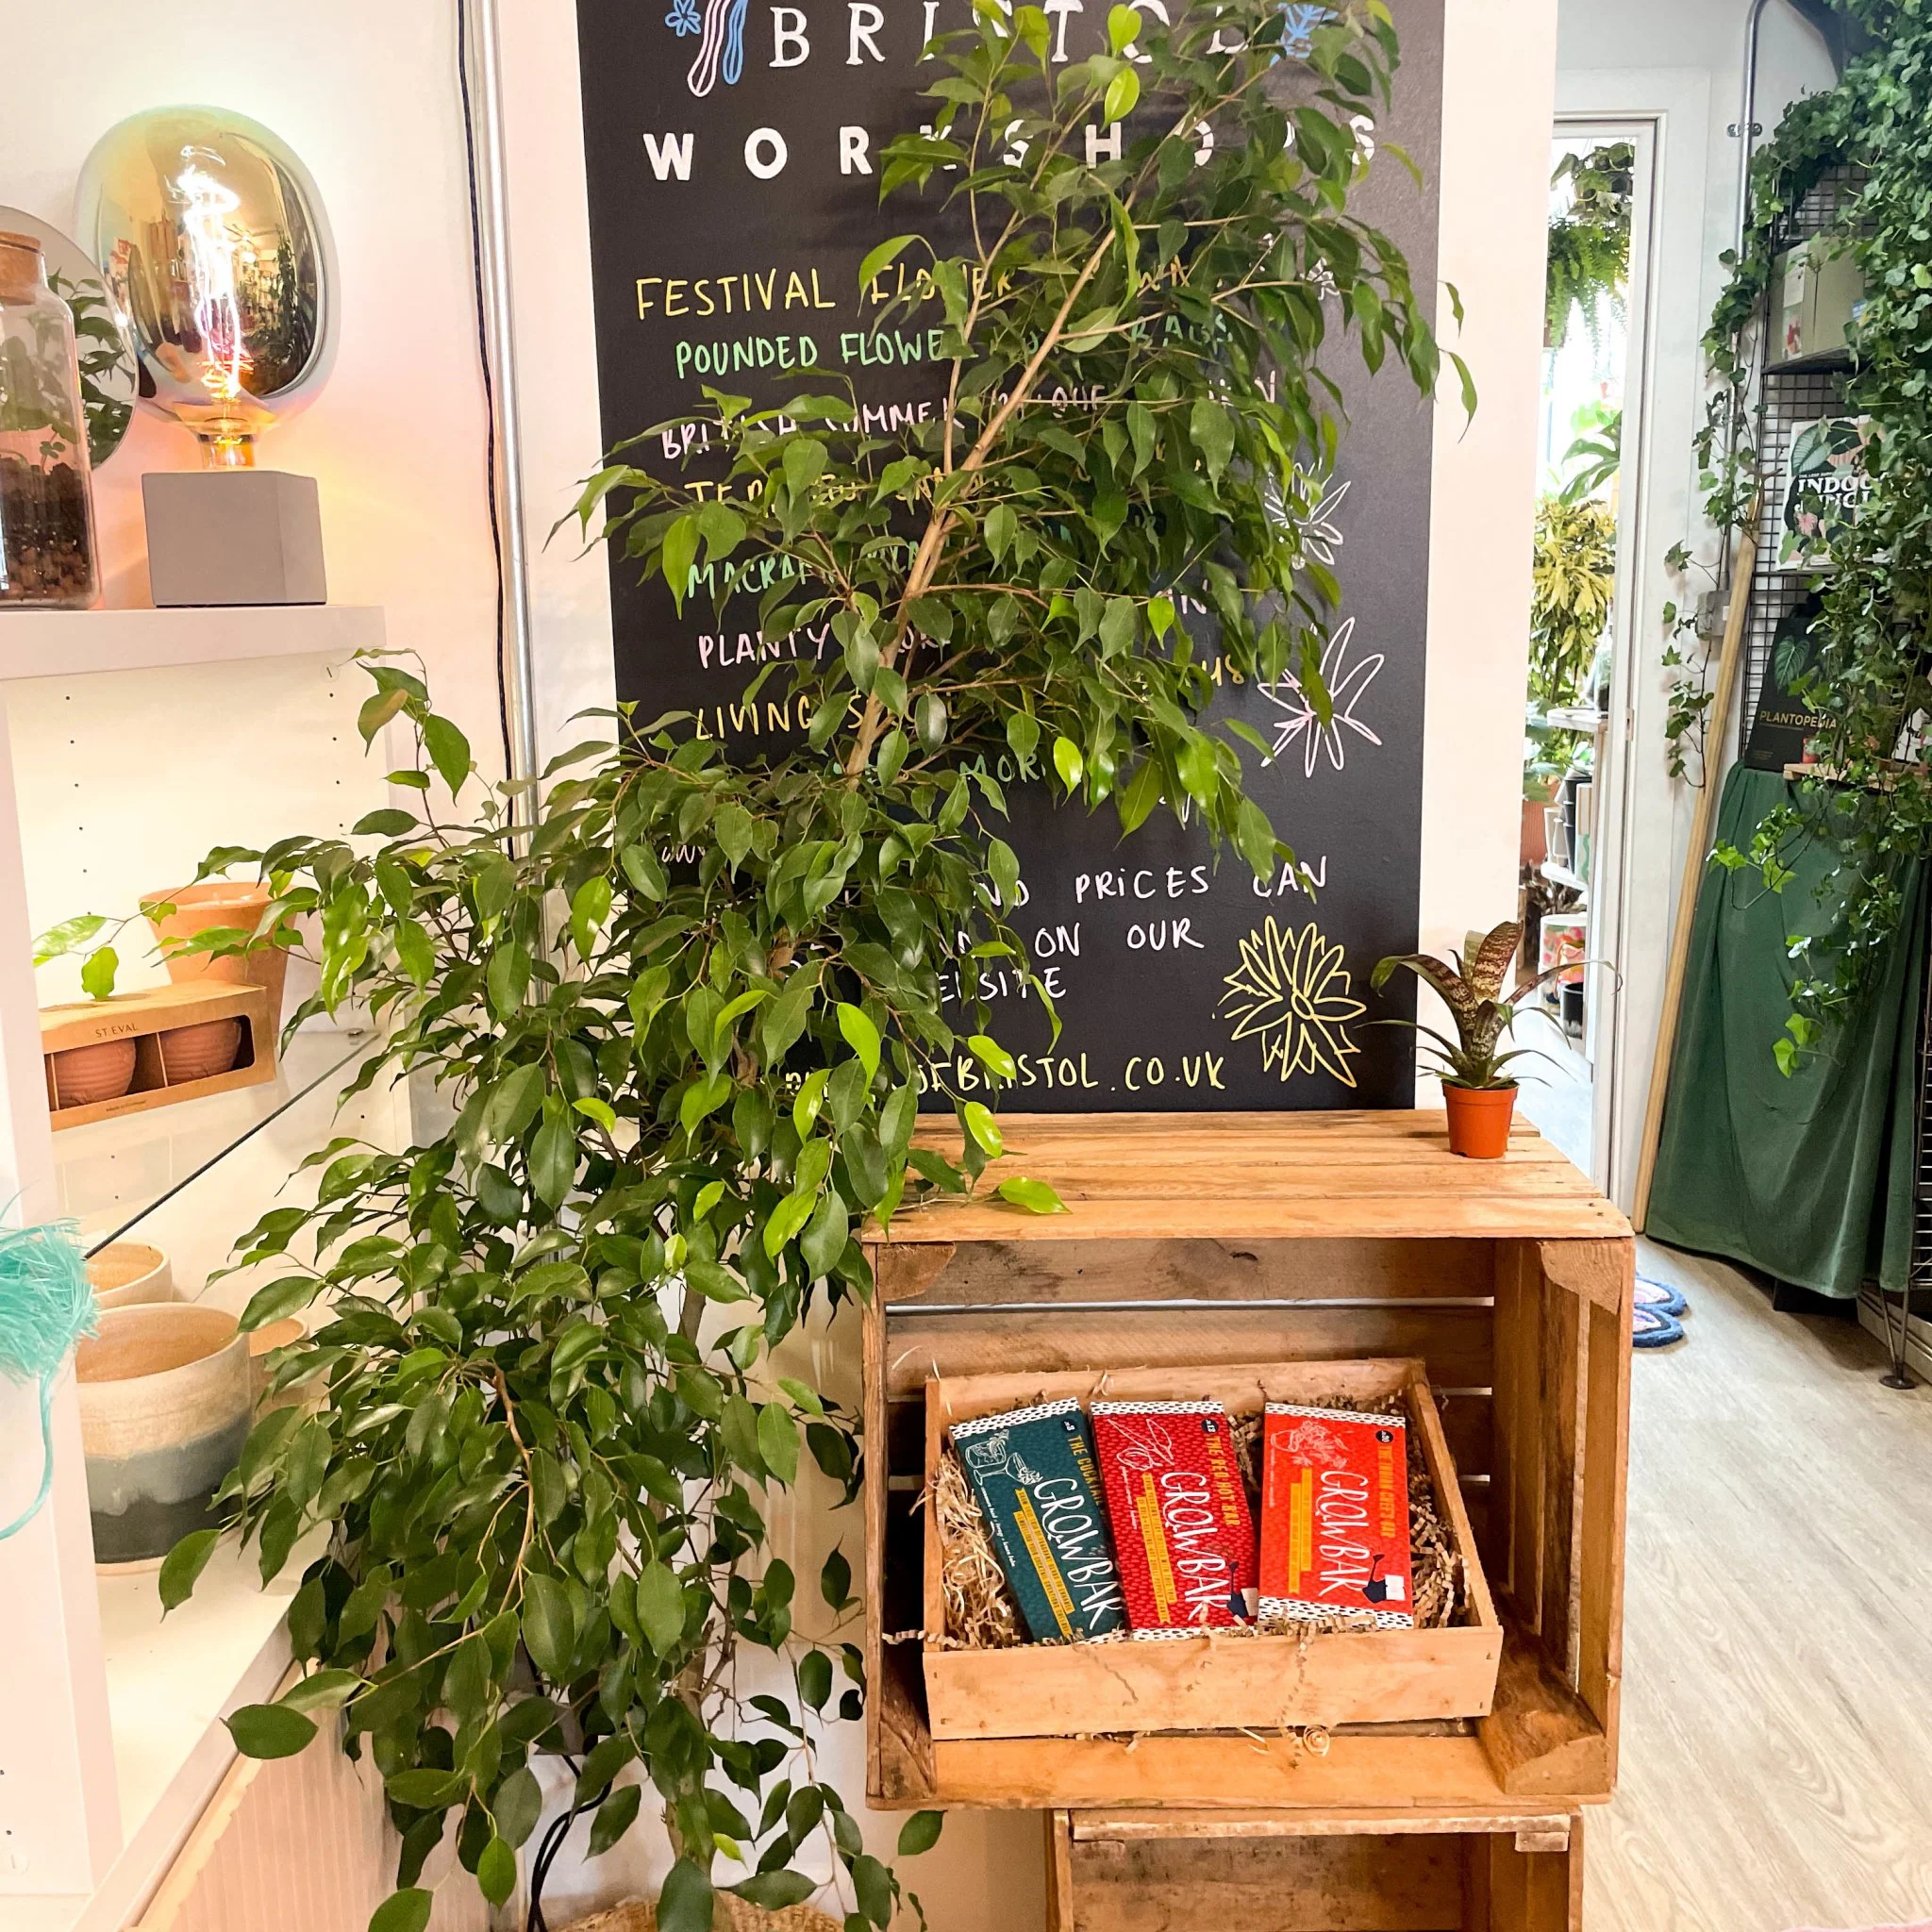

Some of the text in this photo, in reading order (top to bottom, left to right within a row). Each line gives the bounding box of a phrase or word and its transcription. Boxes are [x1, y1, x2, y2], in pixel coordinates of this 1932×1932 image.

[642, 114, 1375, 181] WORSHOS
[636, 263, 1011, 320] FESTIVAL FLOER
[675, 330, 946, 379] POUNDED FLOWE
[824, 397, 966, 433] MMER
[1798, 475, 1874, 494] INDOO
[698, 623, 830, 669] PLANTY
[696, 695, 815, 740] LIVING
[1758, 710, 1838, 729] PLANTOPEDIA
[959, 754, 1046, 783] MOR
[1075, 865, 1209, 904] PRICES
[1253, 856, 1327, 899] CAN
[1035, 917, 1205, 958] ON OUR
[95, 1023, 139, 1038] ST EVAL
[1067, 1435, 1103, 1507] THE COCKTAIL
[1207, 1435, 1241, 1525] THE RED HOT BAR
[1034, 1477, 1123, 1630] GROWBAR
[1160, 1472, 1231, 1621] GROWBAR
[1316, 1470, 1370, 1597] GROWBAR
